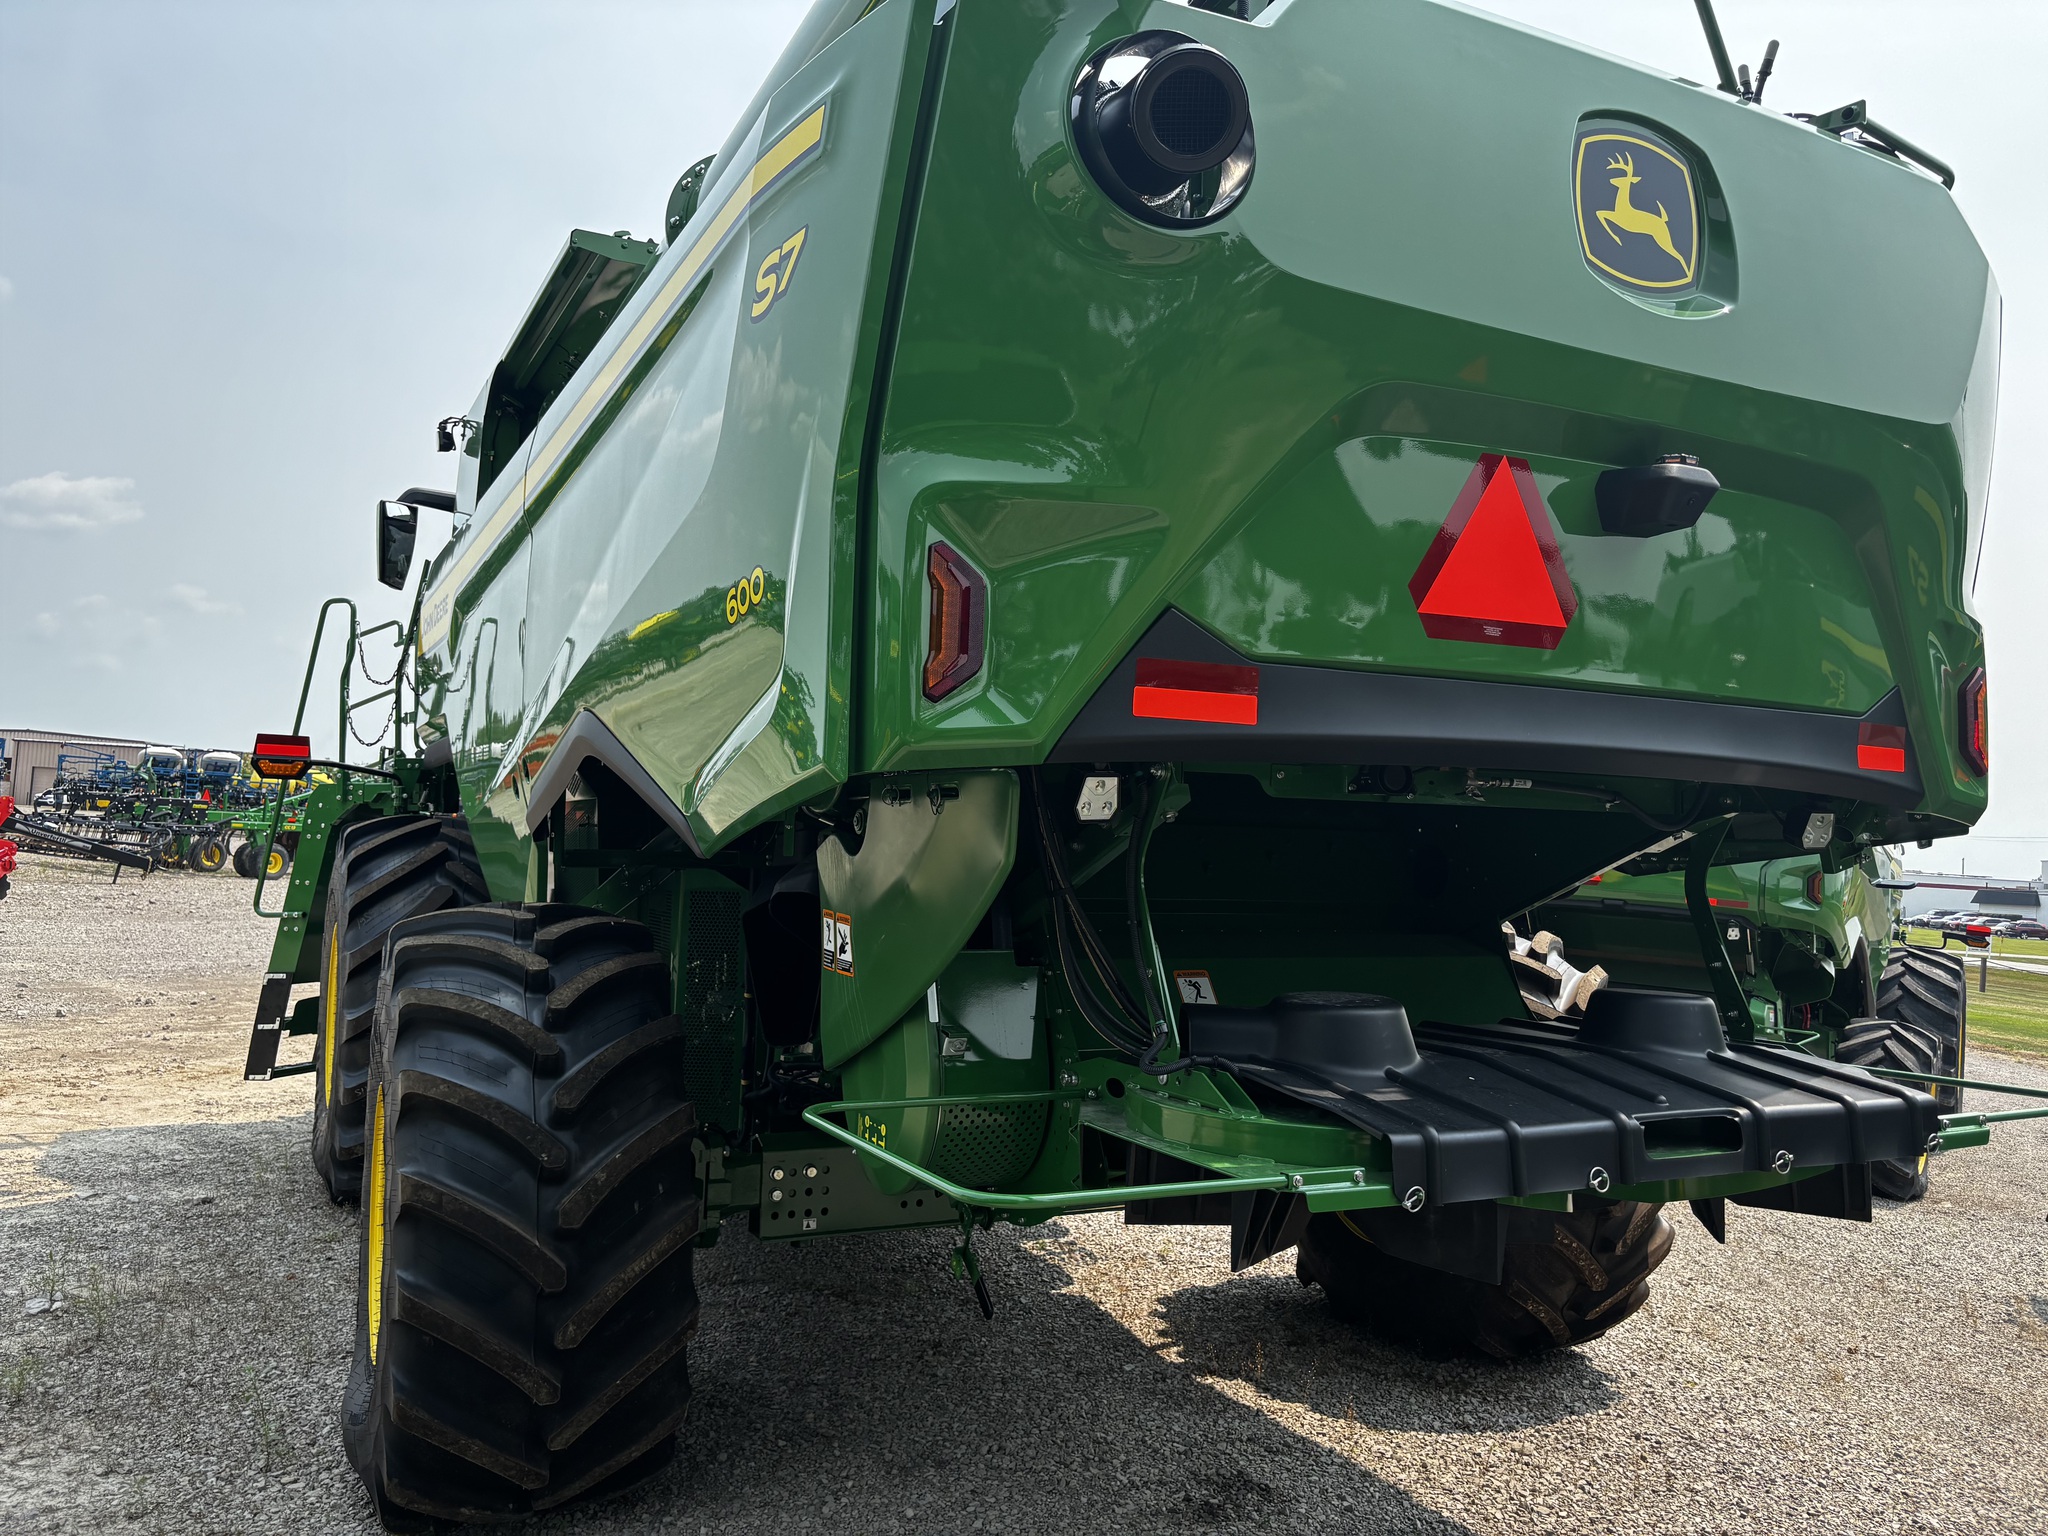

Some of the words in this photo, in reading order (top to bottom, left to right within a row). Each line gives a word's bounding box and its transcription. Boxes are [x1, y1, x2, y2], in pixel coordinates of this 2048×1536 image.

[750, 225, 809, 323] S7
[434, 594, 448, 627] DEERE
[726, 566, 765, 625] 600
